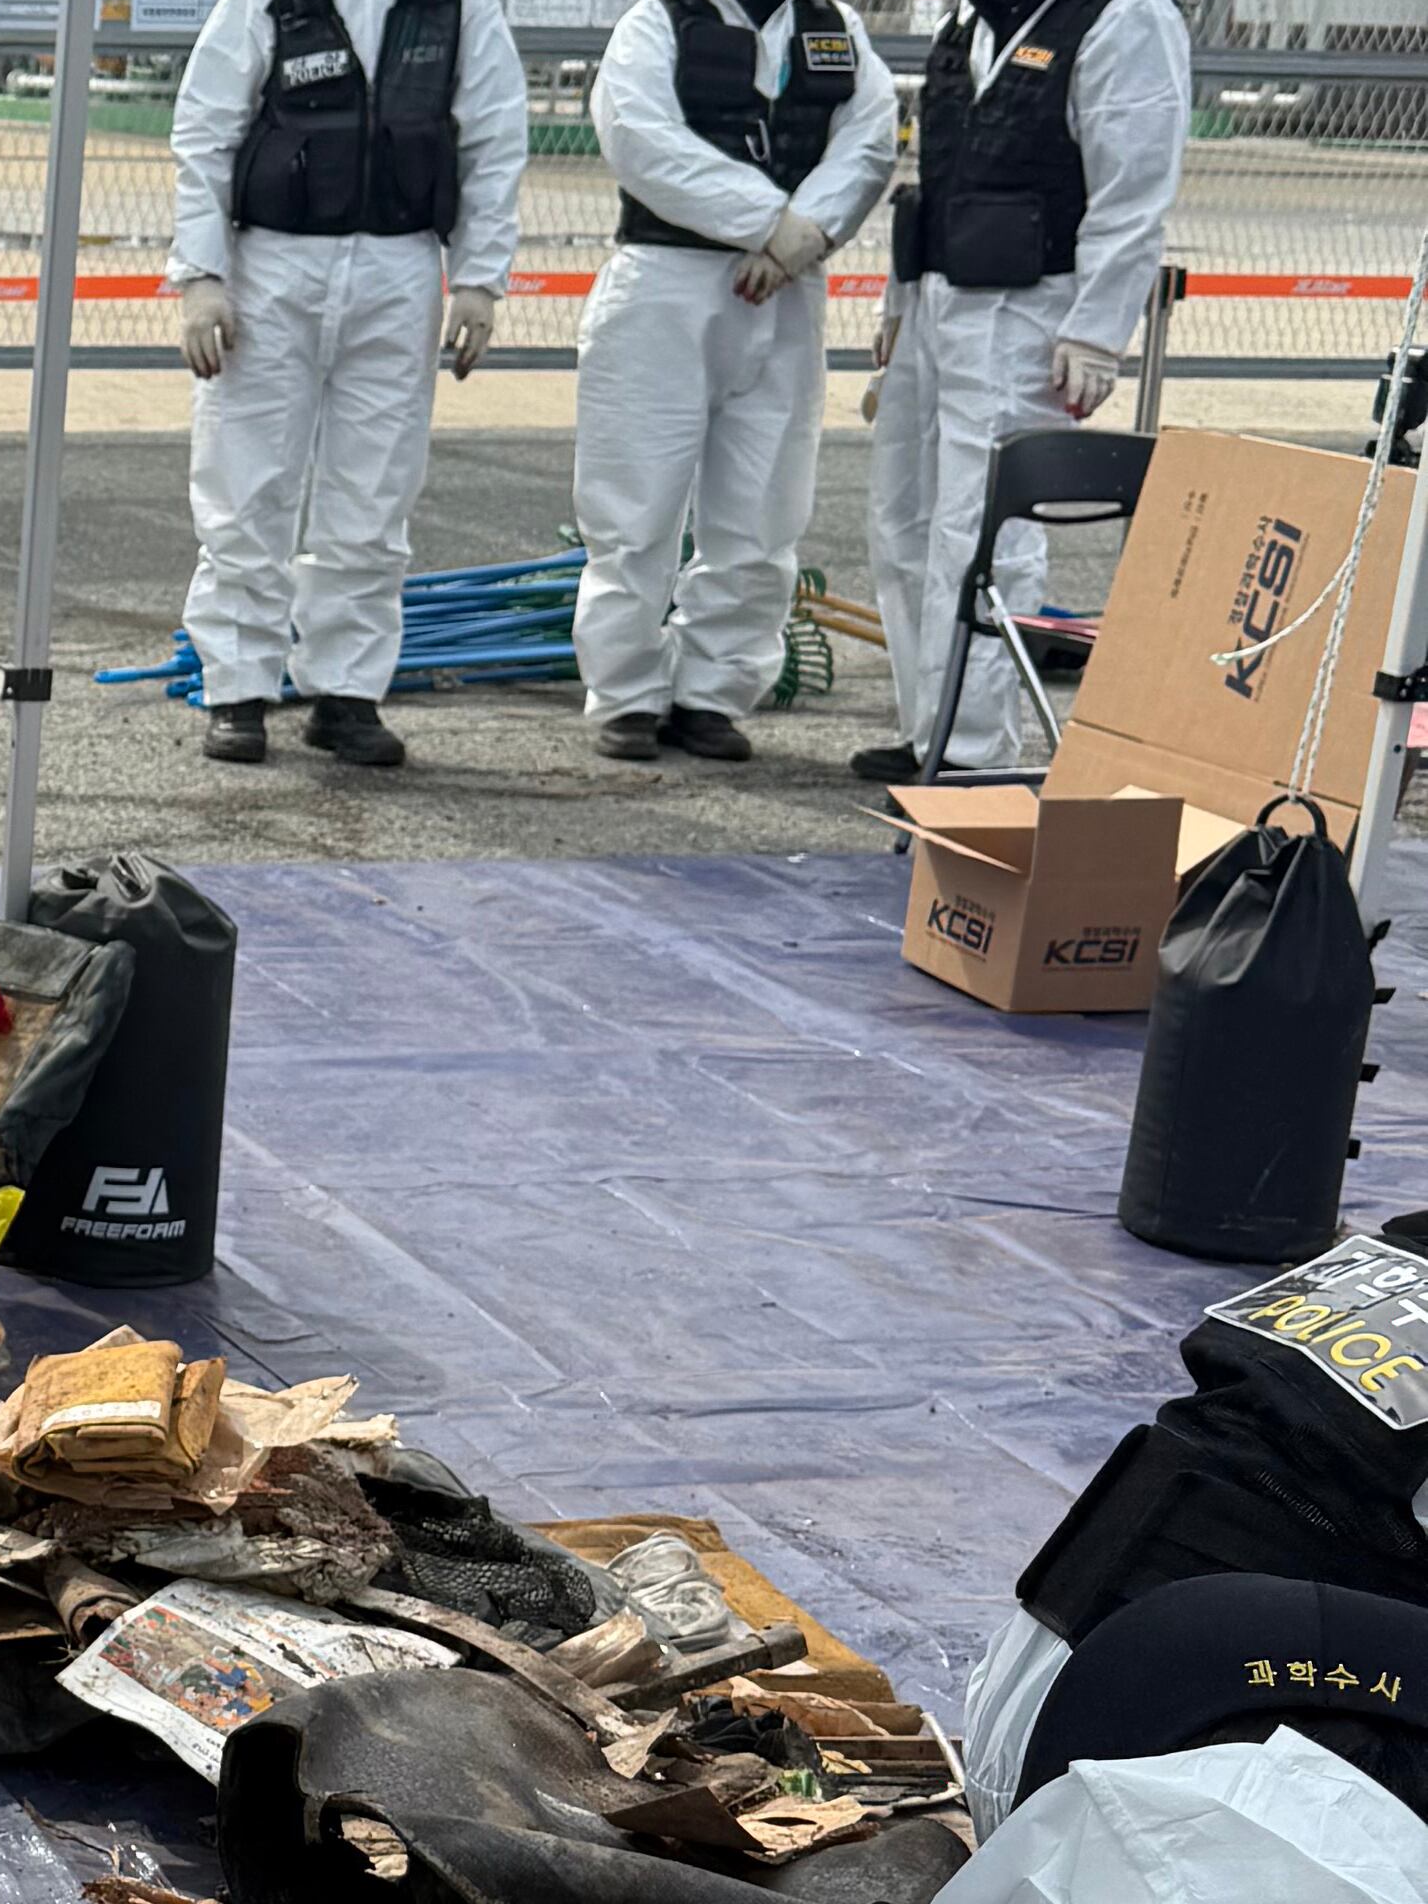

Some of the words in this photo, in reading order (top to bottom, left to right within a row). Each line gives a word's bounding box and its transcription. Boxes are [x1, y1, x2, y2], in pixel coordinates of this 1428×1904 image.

[1224, 518, 1302, 699] KCSI
[927, 899, 993, 955] KCSI
[1043, 938, 1142, 965] KCSI
[1248, 1295, 1425, 1392] POLICE
[1245, 1658, 1403, 1703] 과학수사
